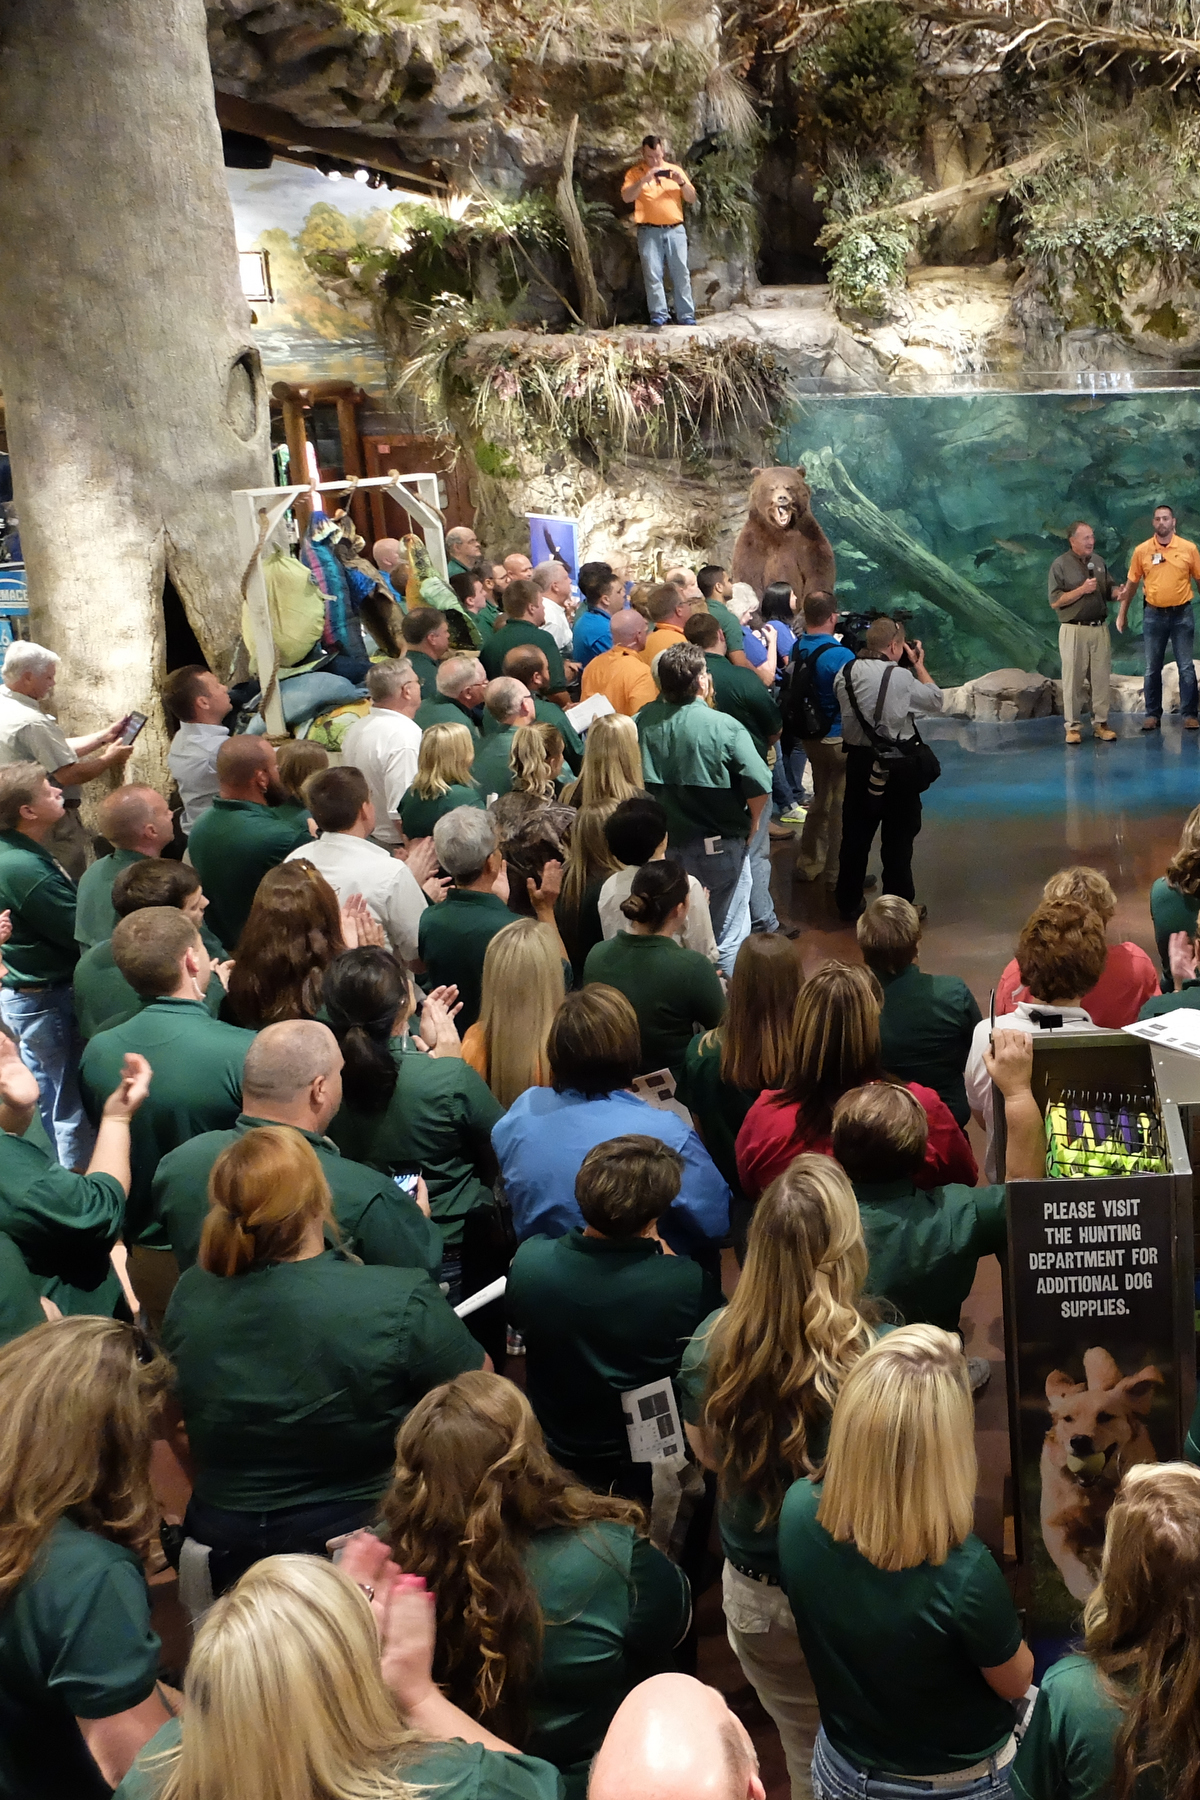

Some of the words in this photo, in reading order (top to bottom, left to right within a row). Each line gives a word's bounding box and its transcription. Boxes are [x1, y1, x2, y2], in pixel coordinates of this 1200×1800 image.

[0, 589, 28, 601] MACE
[1044, 1201, 1096, 1220] PLEASE
[1102, 1199, 1141, 1218] VISIT
[1044, 1227, 1073, 1245] THE
[1079, 1224, 1142, 1243] HUNTING
[1029, 1249, 1125, 1270] DEPARTMENT
[1132, 1247, 1158, 1266] FOR
[1036, 1274, 1119, 1294] ADDITIONAL
[1125, 1272, 1153, 1290] DOG
[1061, 1298, 1130, 1318] SUPPLIES.
